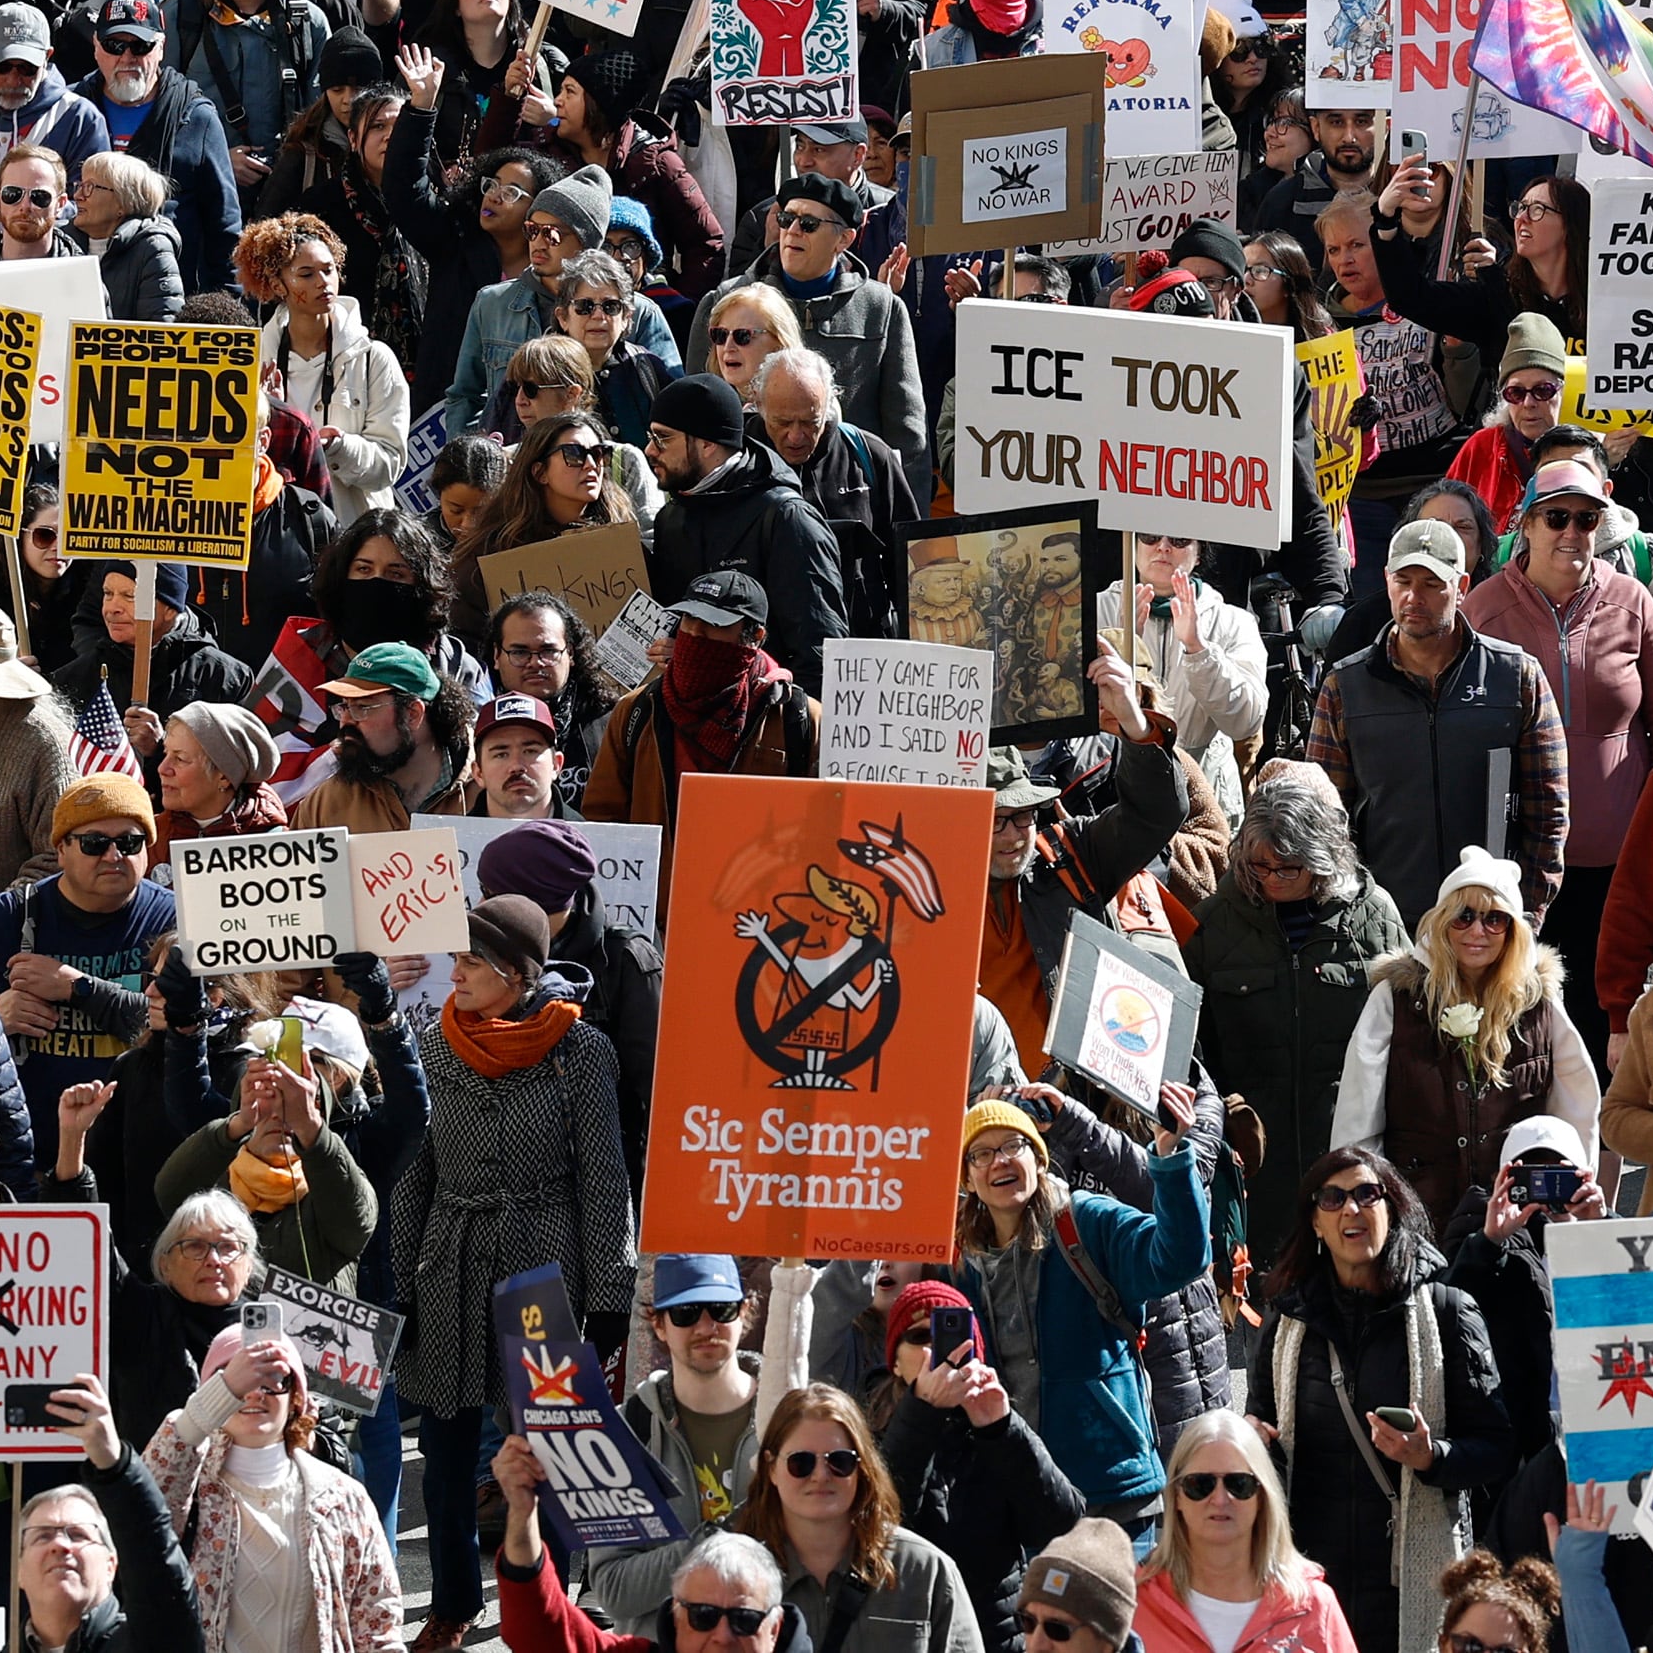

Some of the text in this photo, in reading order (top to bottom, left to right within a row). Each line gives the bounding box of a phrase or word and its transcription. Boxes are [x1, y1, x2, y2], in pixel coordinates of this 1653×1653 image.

[719, 74, 854, 124] RESIST!
[991, 346, 1241, 418] ICE TOOK
[967, 427, 1272, 512] YOUR NEIGHBOR
[681, 1106, 929, 1172] Sic Semper
[709, 1160, 902, 1220] Tyrannis
[814, 1236, 946, 1259] NoCaesars.org
[524, 1410, 602, 1426] CHICAGO SAYS
[528, 1431, 631, 1491] NO
[565, 1485, 654, 1518] KINGS
